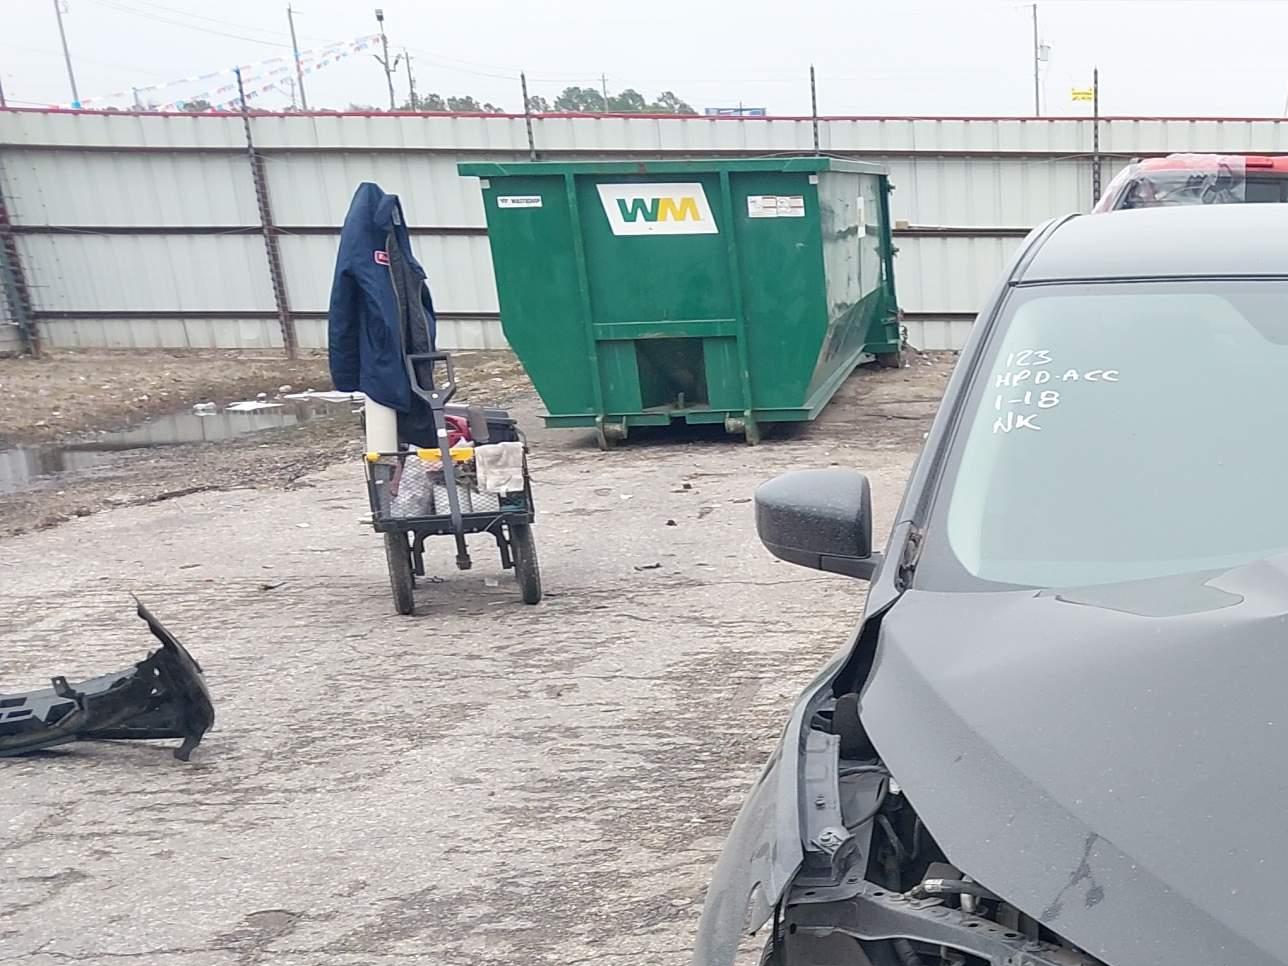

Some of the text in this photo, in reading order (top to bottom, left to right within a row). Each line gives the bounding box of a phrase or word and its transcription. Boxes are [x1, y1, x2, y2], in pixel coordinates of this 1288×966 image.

[616, 197, 702, 223] WM
[1006, 350, 1053, 367] 123
[995, 390, 1060, 410] 1-18
[992, 411, 1042, 434] NK
